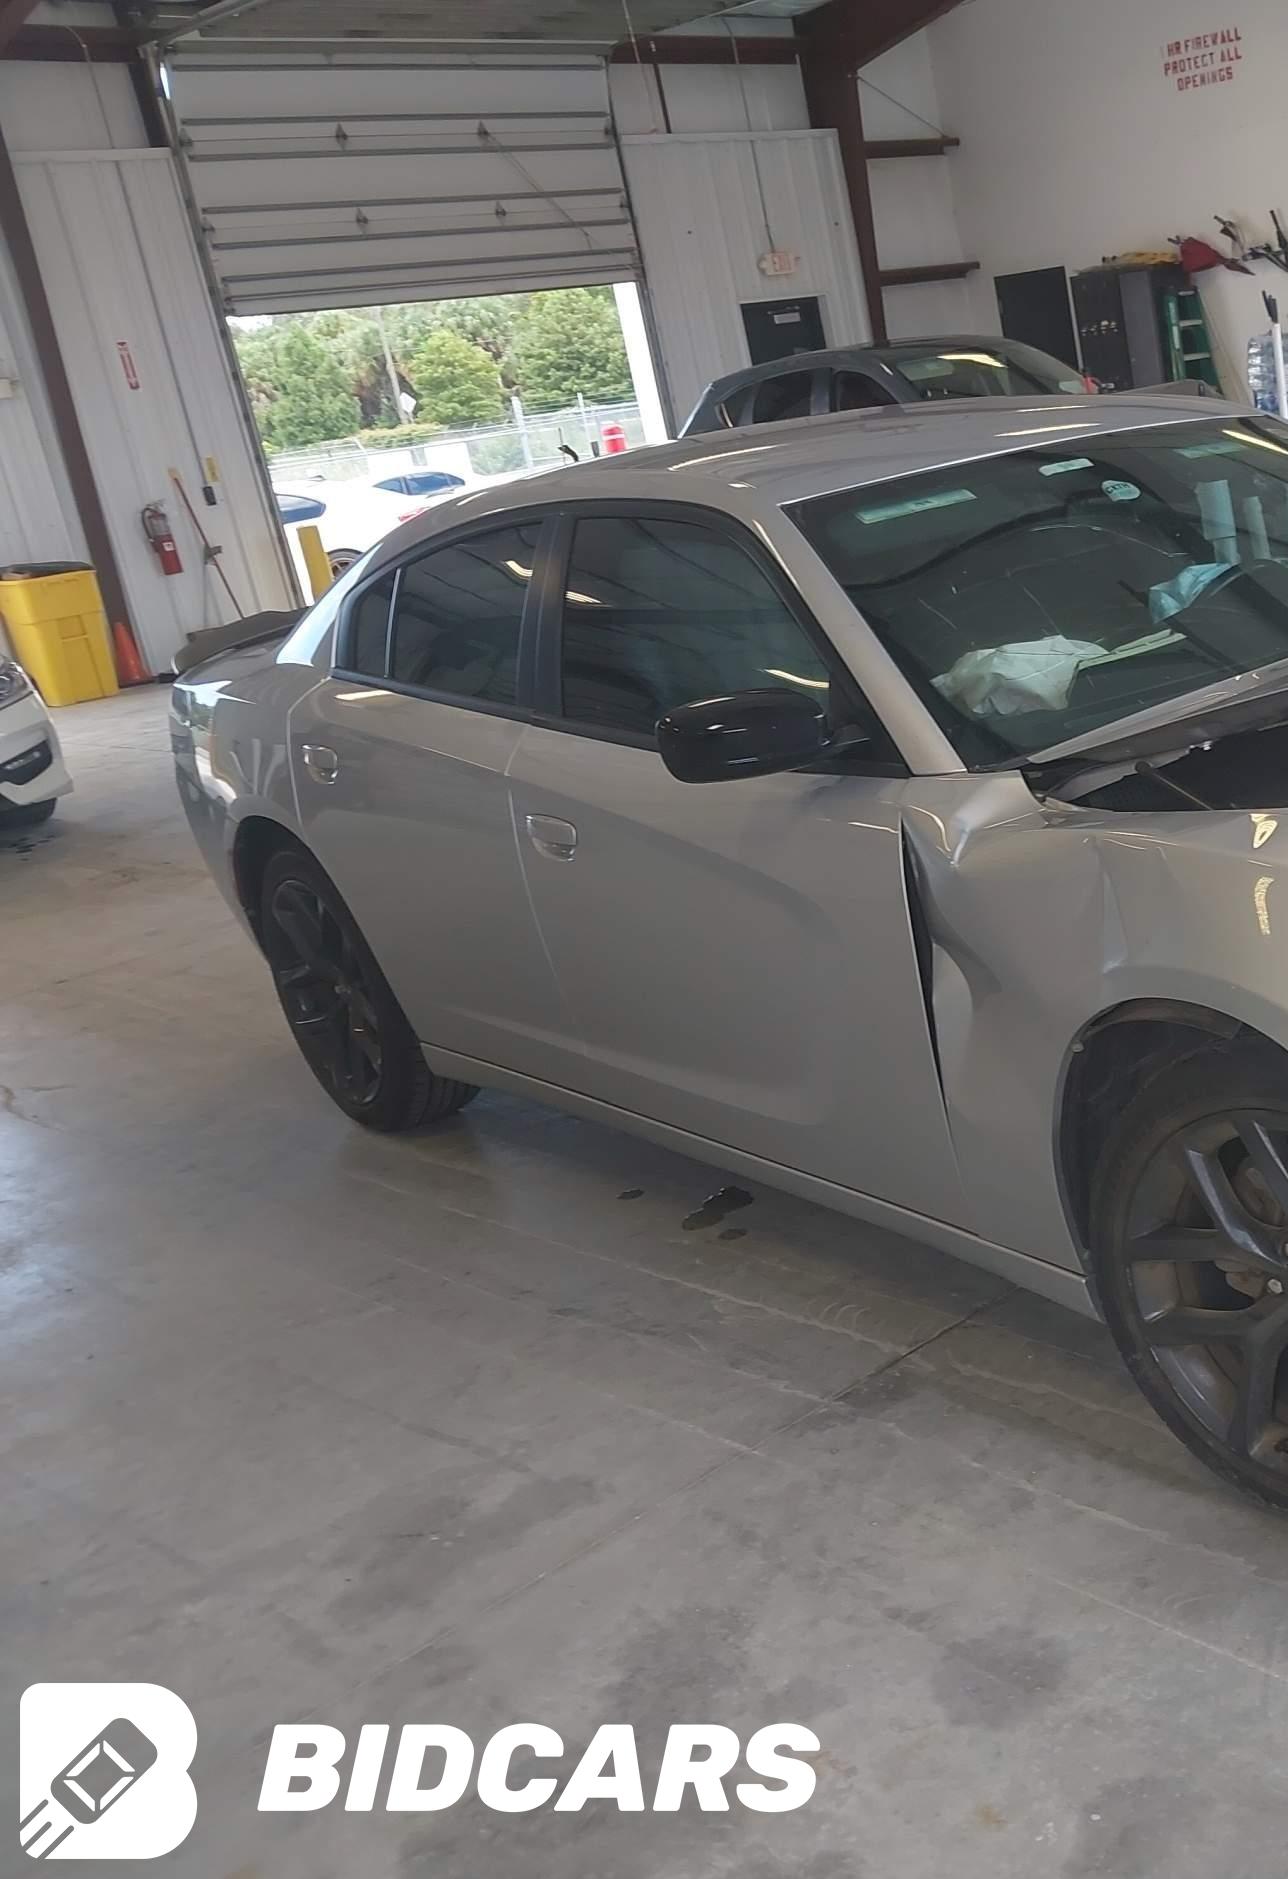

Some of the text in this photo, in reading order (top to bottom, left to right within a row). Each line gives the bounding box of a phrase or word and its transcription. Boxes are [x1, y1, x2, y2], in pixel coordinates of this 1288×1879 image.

[1167, 41, 1181, 57] HR
[1184, 27, 1242, 53] FIREWALL
[1164, 46, 1242, 76] PROTECT ALL
[1177, 66, 1233, 91] OPENINGS
